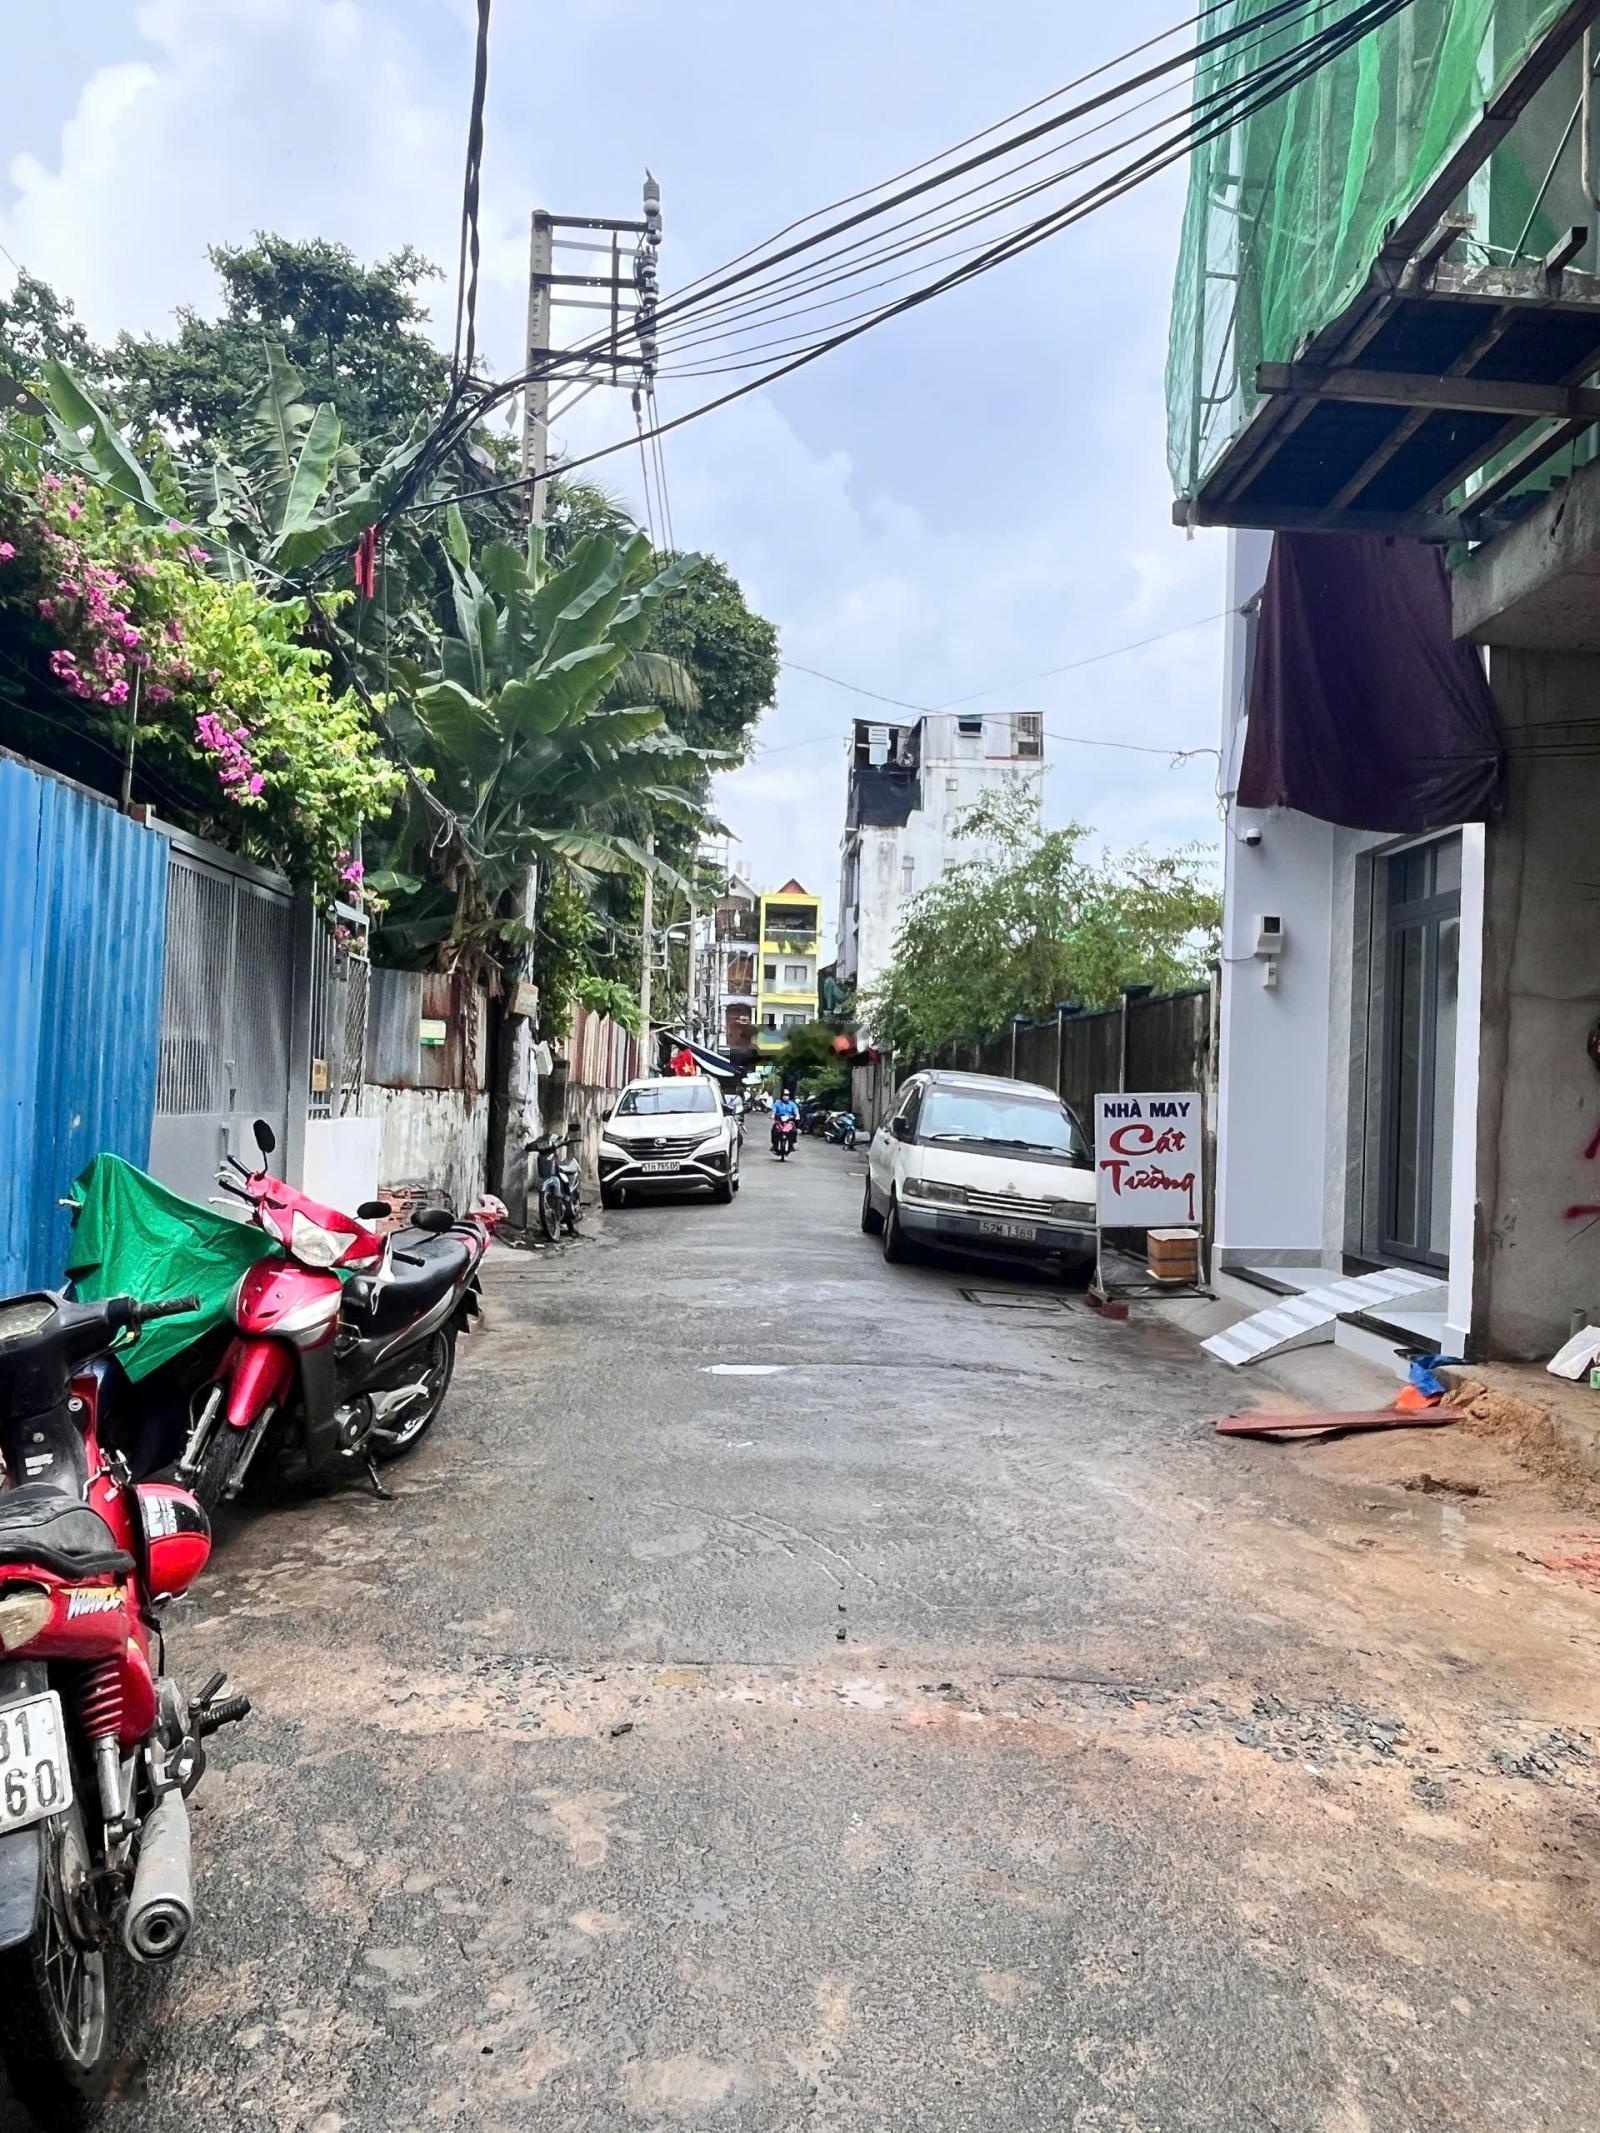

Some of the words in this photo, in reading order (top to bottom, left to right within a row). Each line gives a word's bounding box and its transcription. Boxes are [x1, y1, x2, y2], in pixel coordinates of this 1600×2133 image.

[1104, 1099, 1142, 1118] NHÀ
[1149, 1102, 1191, 1118] MAY
[1109, 1123, 1187, 1156] Cát
[1100, 1160, 1196, 1221] Tường
[5, 1759, 57, 1817] 60
